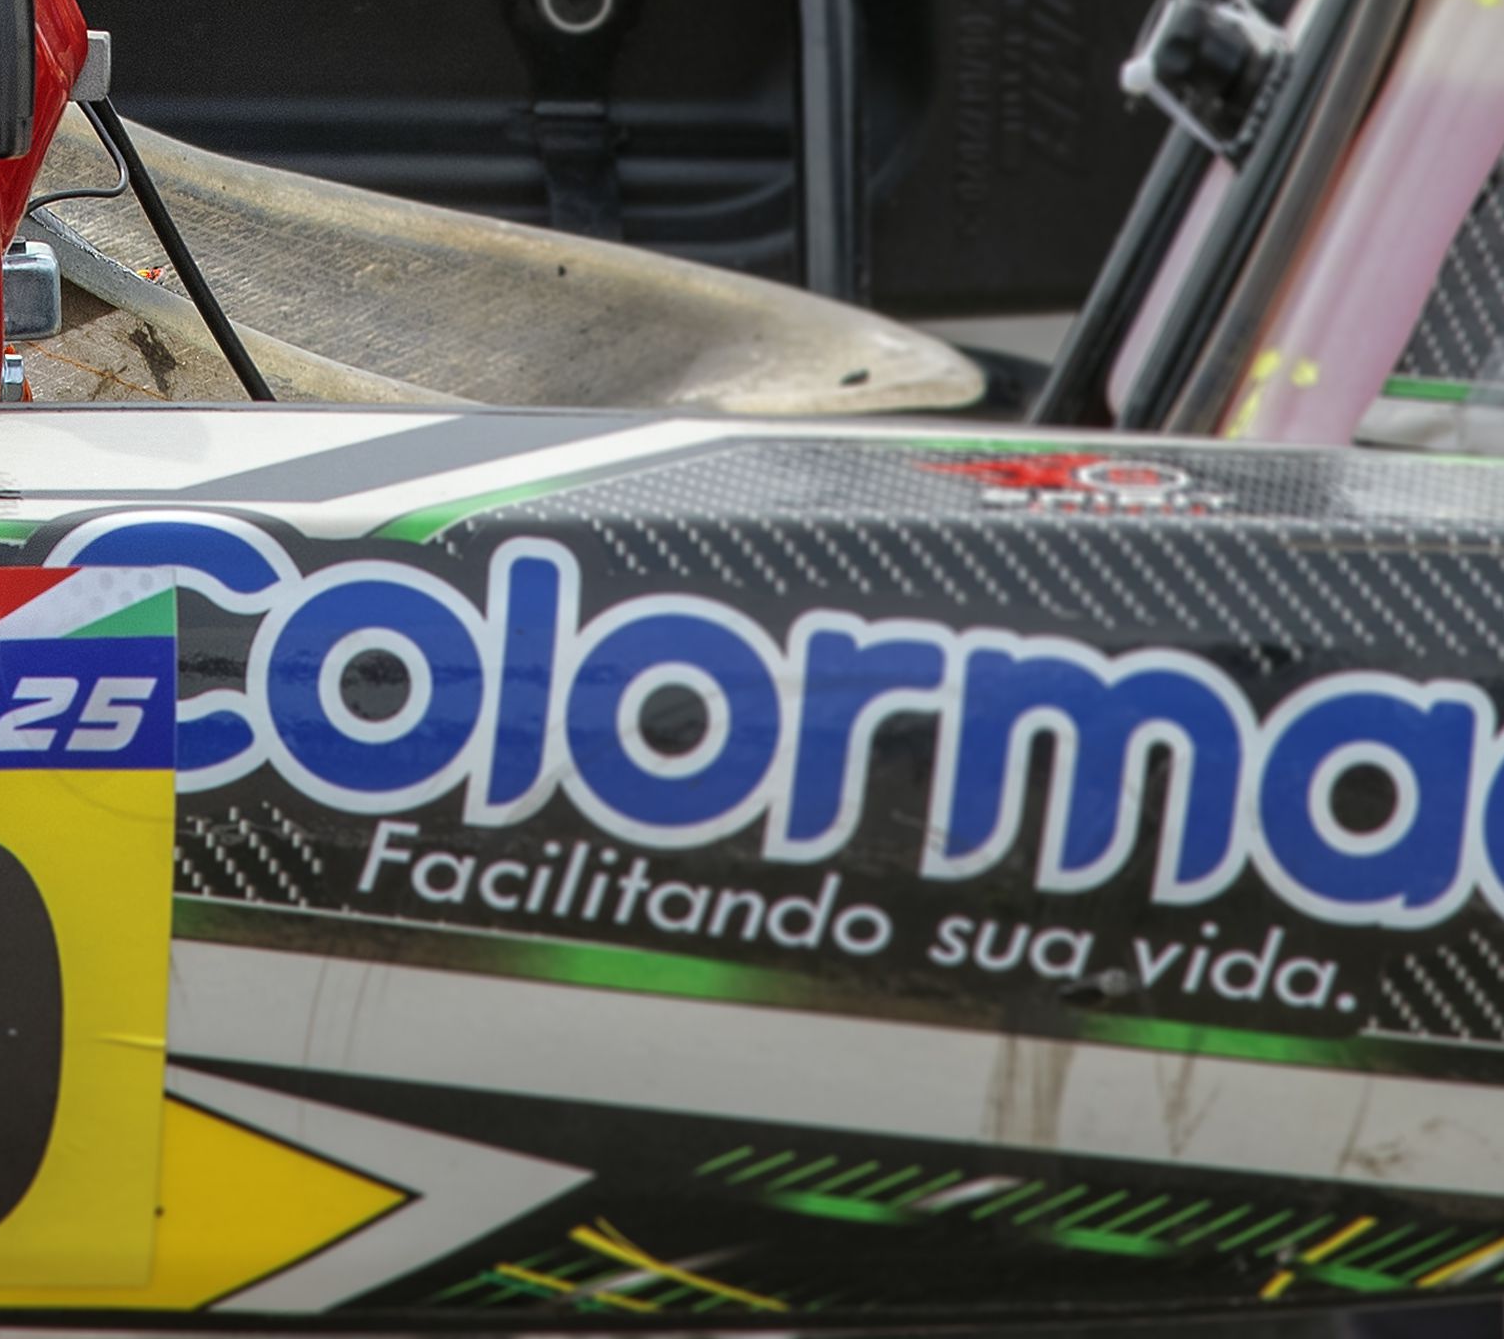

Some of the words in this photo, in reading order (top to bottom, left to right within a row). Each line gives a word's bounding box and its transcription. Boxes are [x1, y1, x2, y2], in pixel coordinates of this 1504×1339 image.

[356, 819, 893, 956] Facilitando
[929, 914, 1093, 981] sua
[1134, 923, 1359, 1014] vida.
